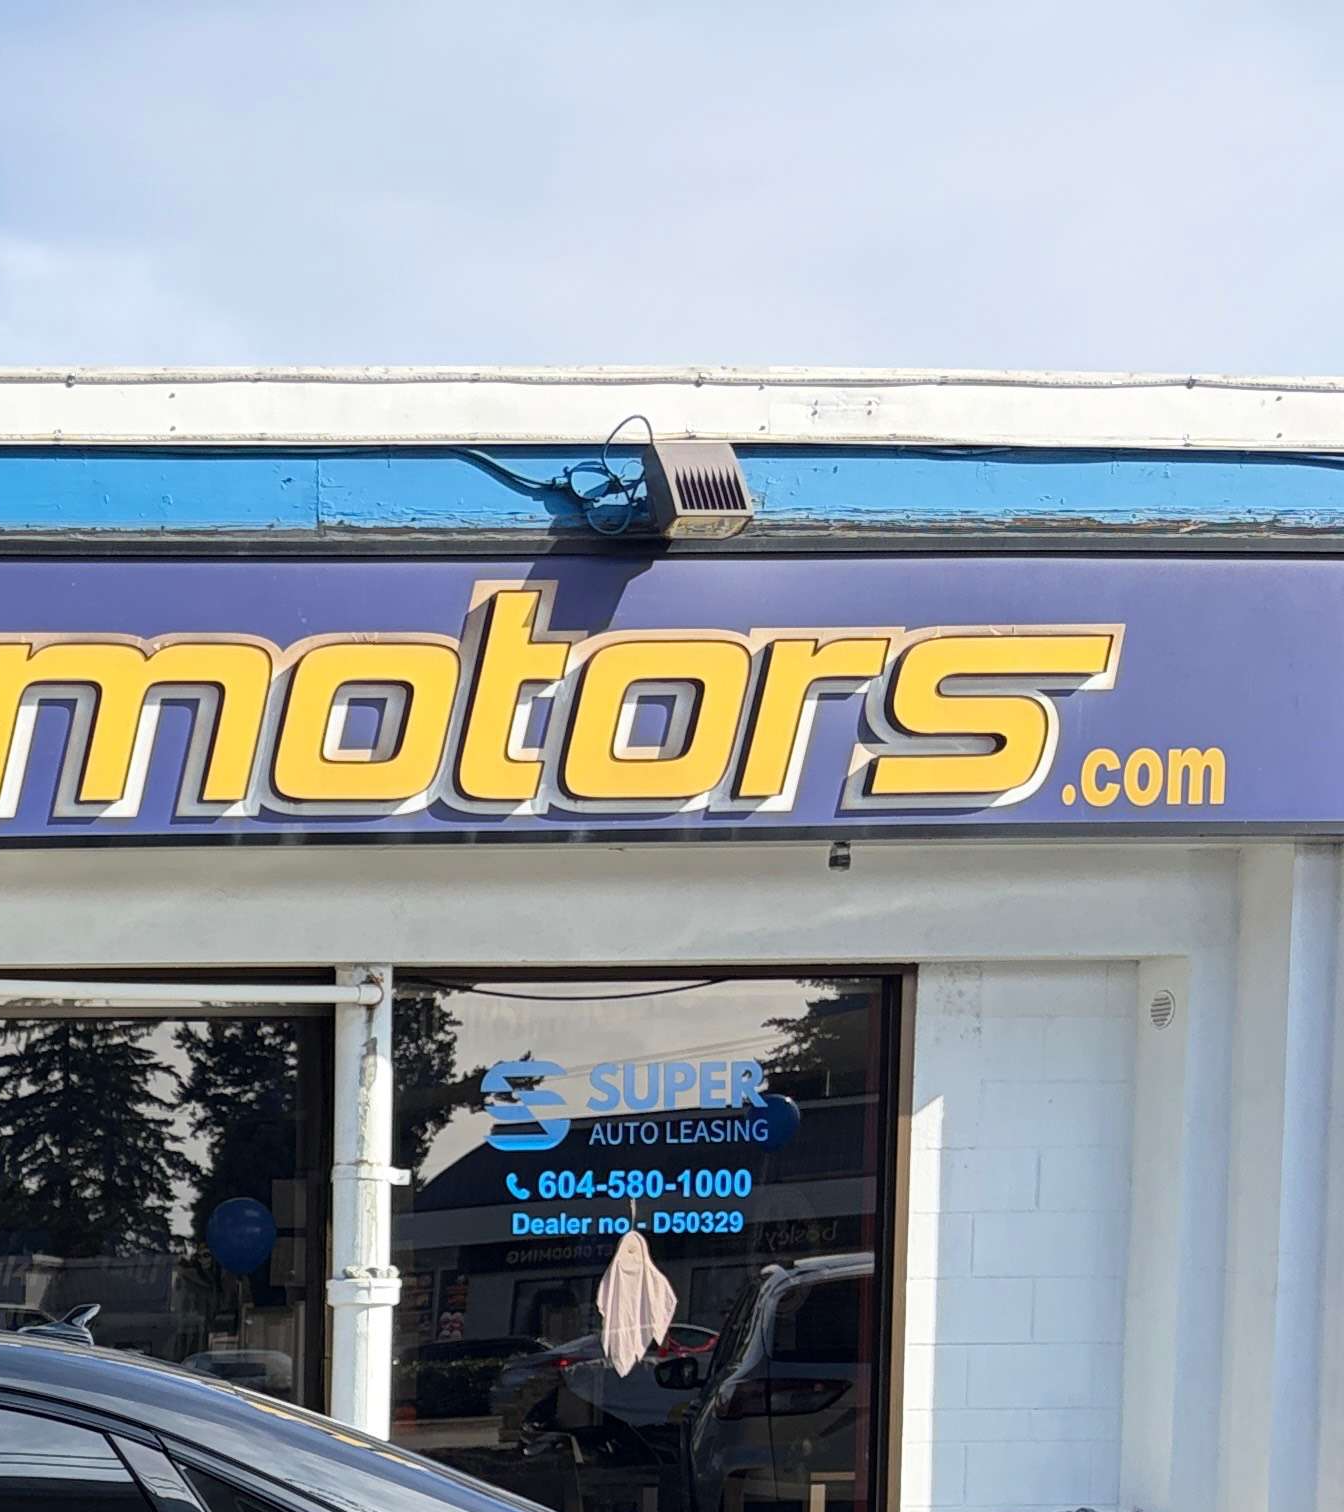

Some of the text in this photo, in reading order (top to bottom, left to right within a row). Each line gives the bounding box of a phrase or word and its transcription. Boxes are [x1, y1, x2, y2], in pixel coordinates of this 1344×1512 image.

[1059, 743, 1227, 807] .com
[587, 1060, 768, 1110] SUPER
[588, 1119, 769, 1146] AUTO LEASING
[538, 1169, 752, 1198] 604-580-1000
[512, 1212, 592, 1235] Dealer
[653, 1211, 744, 1234] D50329
